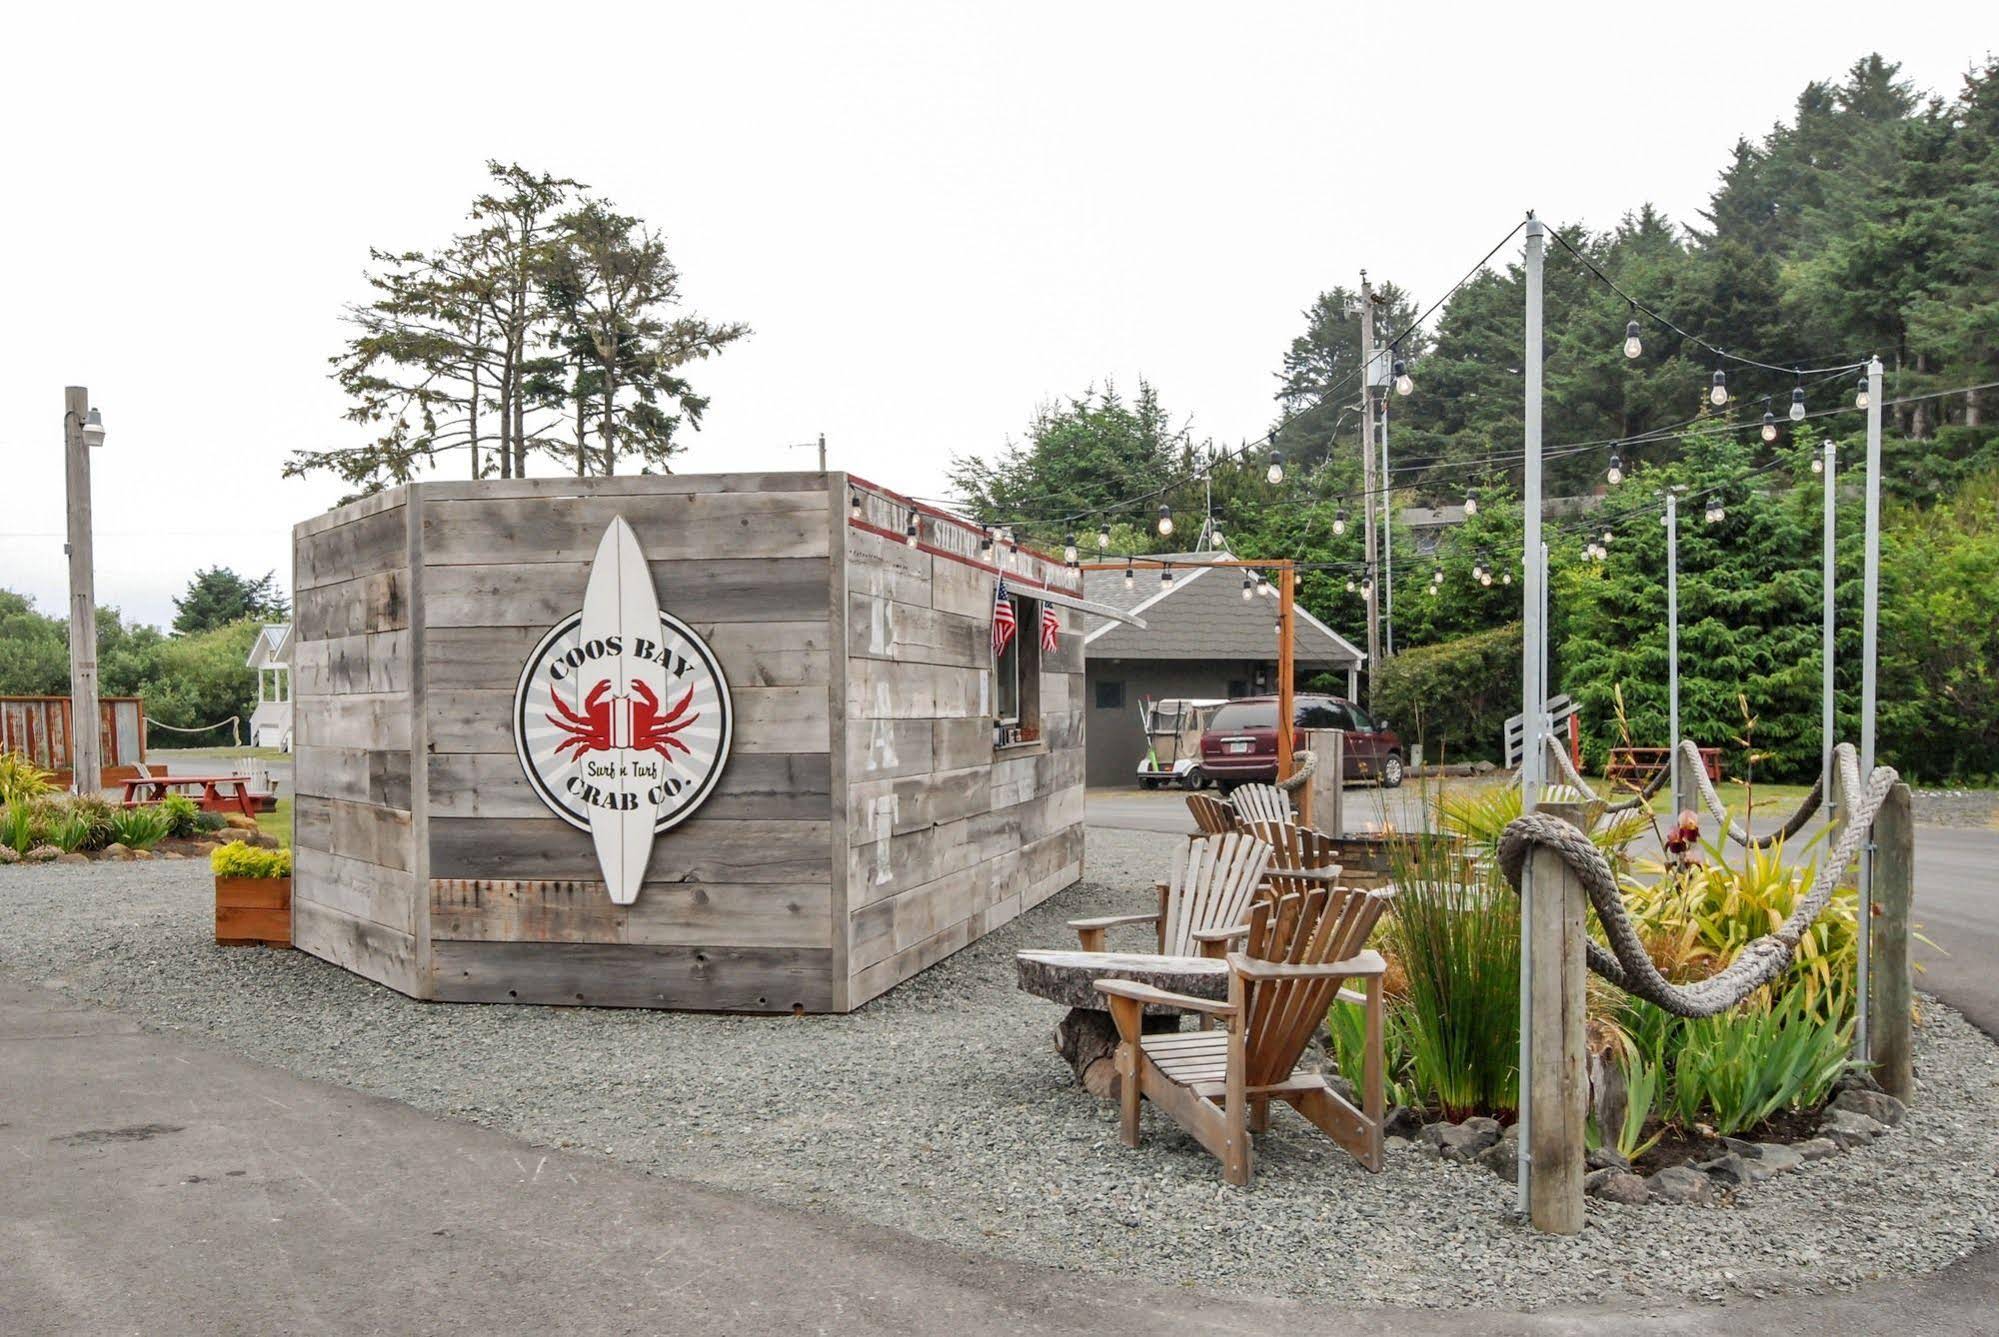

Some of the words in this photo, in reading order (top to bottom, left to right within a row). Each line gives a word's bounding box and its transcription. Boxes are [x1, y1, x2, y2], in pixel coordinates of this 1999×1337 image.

[934, 519, 977, 559] SHRIMP
[550, 636, 623, 680] COOS
[633, 638, 695, 679] BAY
[588, 761, 615, 779] Surf
[620, 768, 628, 776] n
[632, 761, 657, 779] Turf
[566, 777, 638, 810] CRAB
[648, 778, 691, 805] CO.
